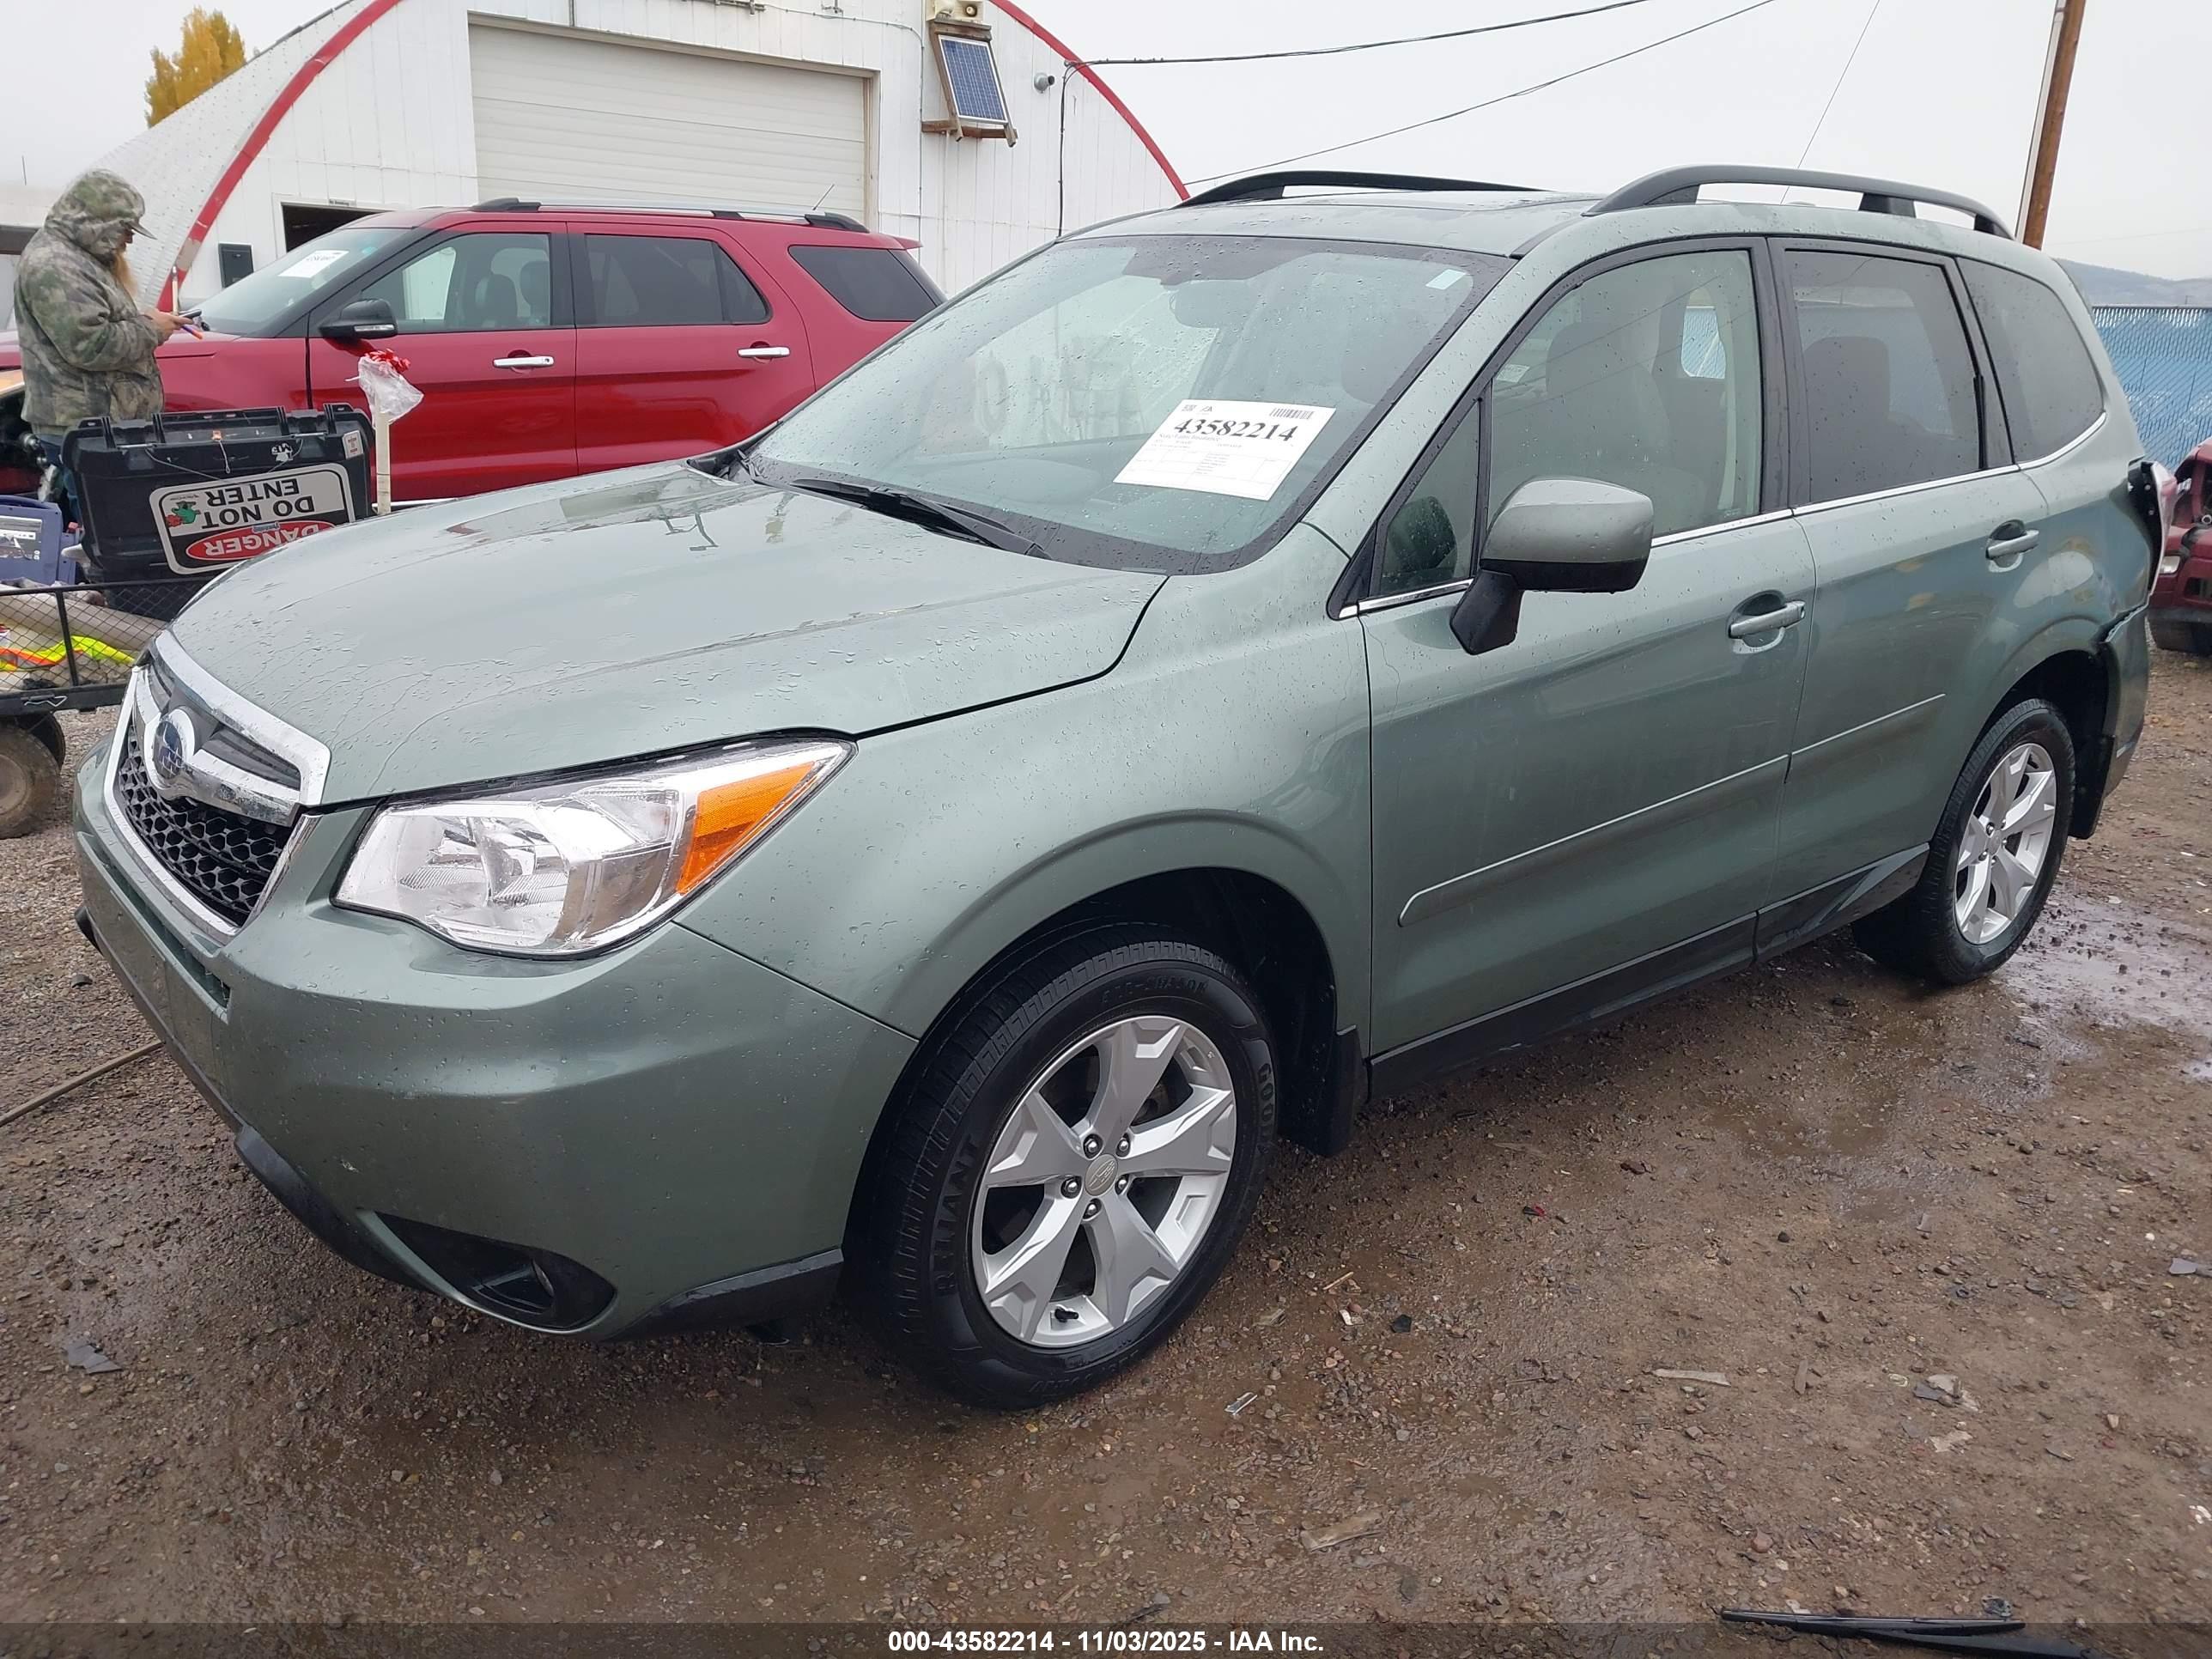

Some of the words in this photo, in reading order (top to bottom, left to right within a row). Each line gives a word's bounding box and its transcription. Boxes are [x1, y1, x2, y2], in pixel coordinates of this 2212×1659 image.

[1174, 418, 1298, 441] 43582214
[206, 478, 301, 507] ENTER
[273, 495, 316, 518] DO
[202, 502, 263, 531] NOT
[204, 524, 320, 556] DANGER
